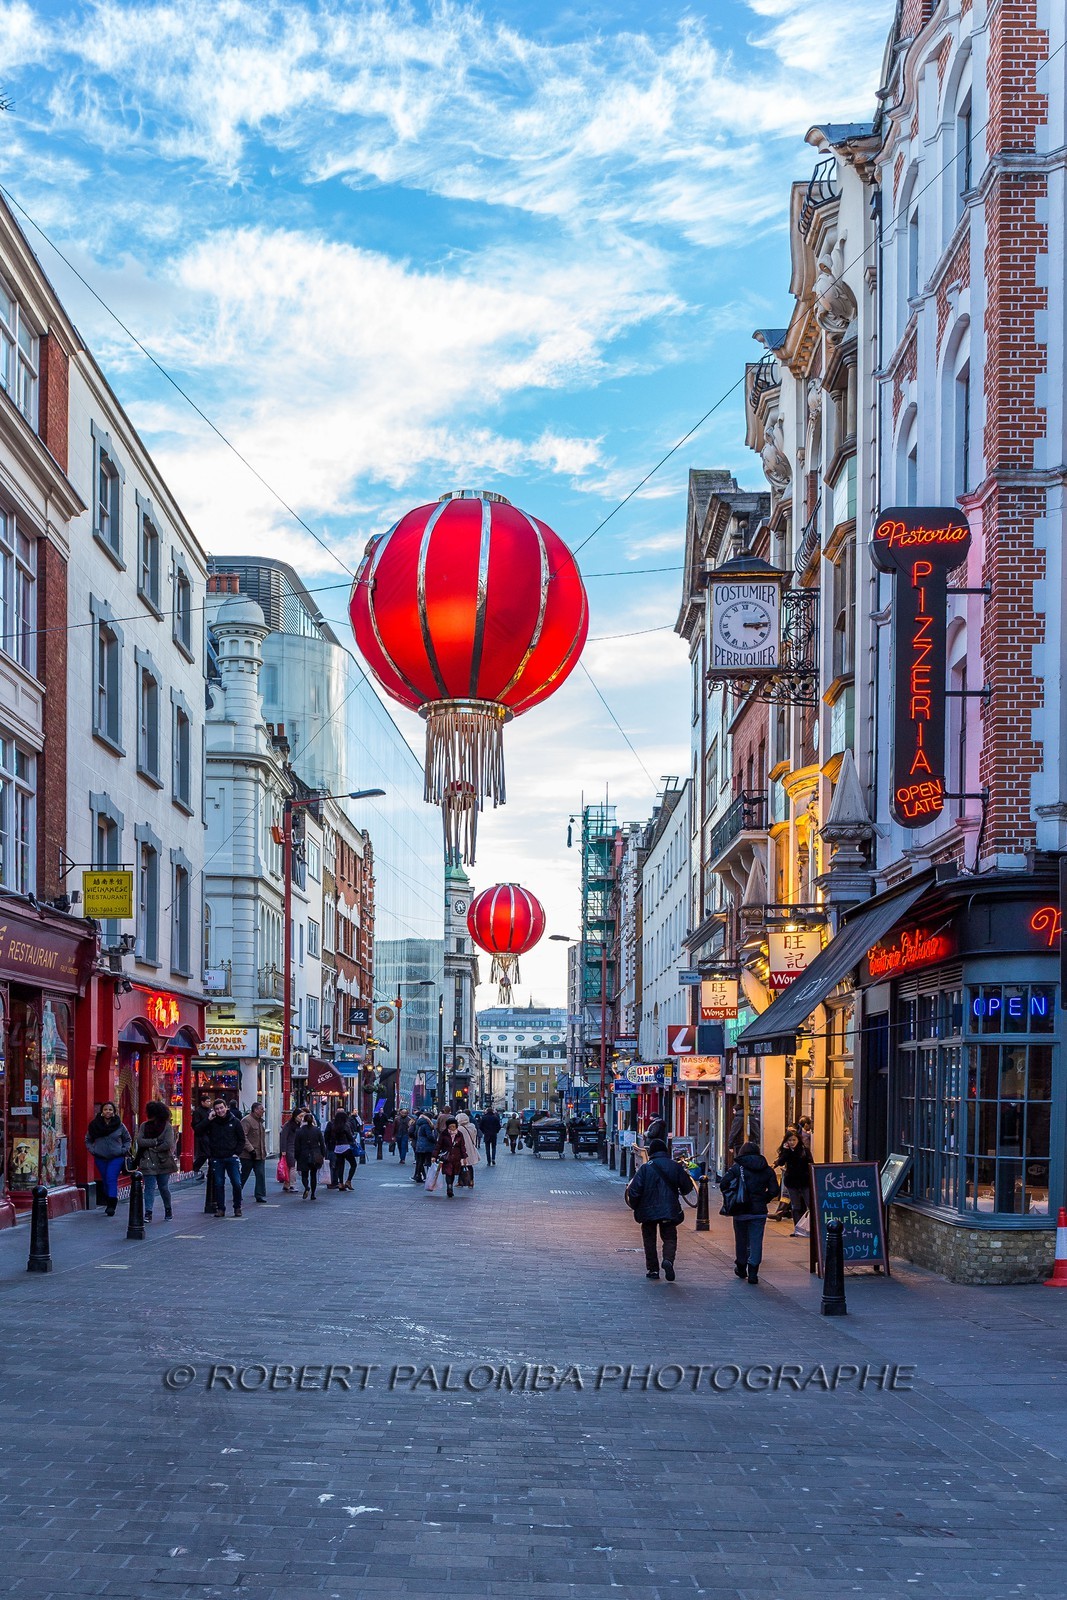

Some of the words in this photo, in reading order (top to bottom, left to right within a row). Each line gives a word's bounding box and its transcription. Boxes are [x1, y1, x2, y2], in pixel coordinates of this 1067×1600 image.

[878, 520, 968, 547] Astoria
[715, 585, 776, 606] COSTUMIER
[714, 644, 776, 666] PERRUQUIER
[910, 561, 933, 775] PIZZERIA
[897, 779, 941, 802] OPEN
[903, 795, 944, 817] LATE
[8, 940, 58, 969] RESTAURANT
[783, 934, 808, 969] 旺記
[711, 983, 728, 1006] 旺記
[703, 1008, 724, 1016] Wong
[726, 1008, 737, 1016] Kei
[973, 997, 1046, 1016] OPEN
[636, 1066, 659, 1075] OPEN
[824, 1172, 868, 1191] Astoria
